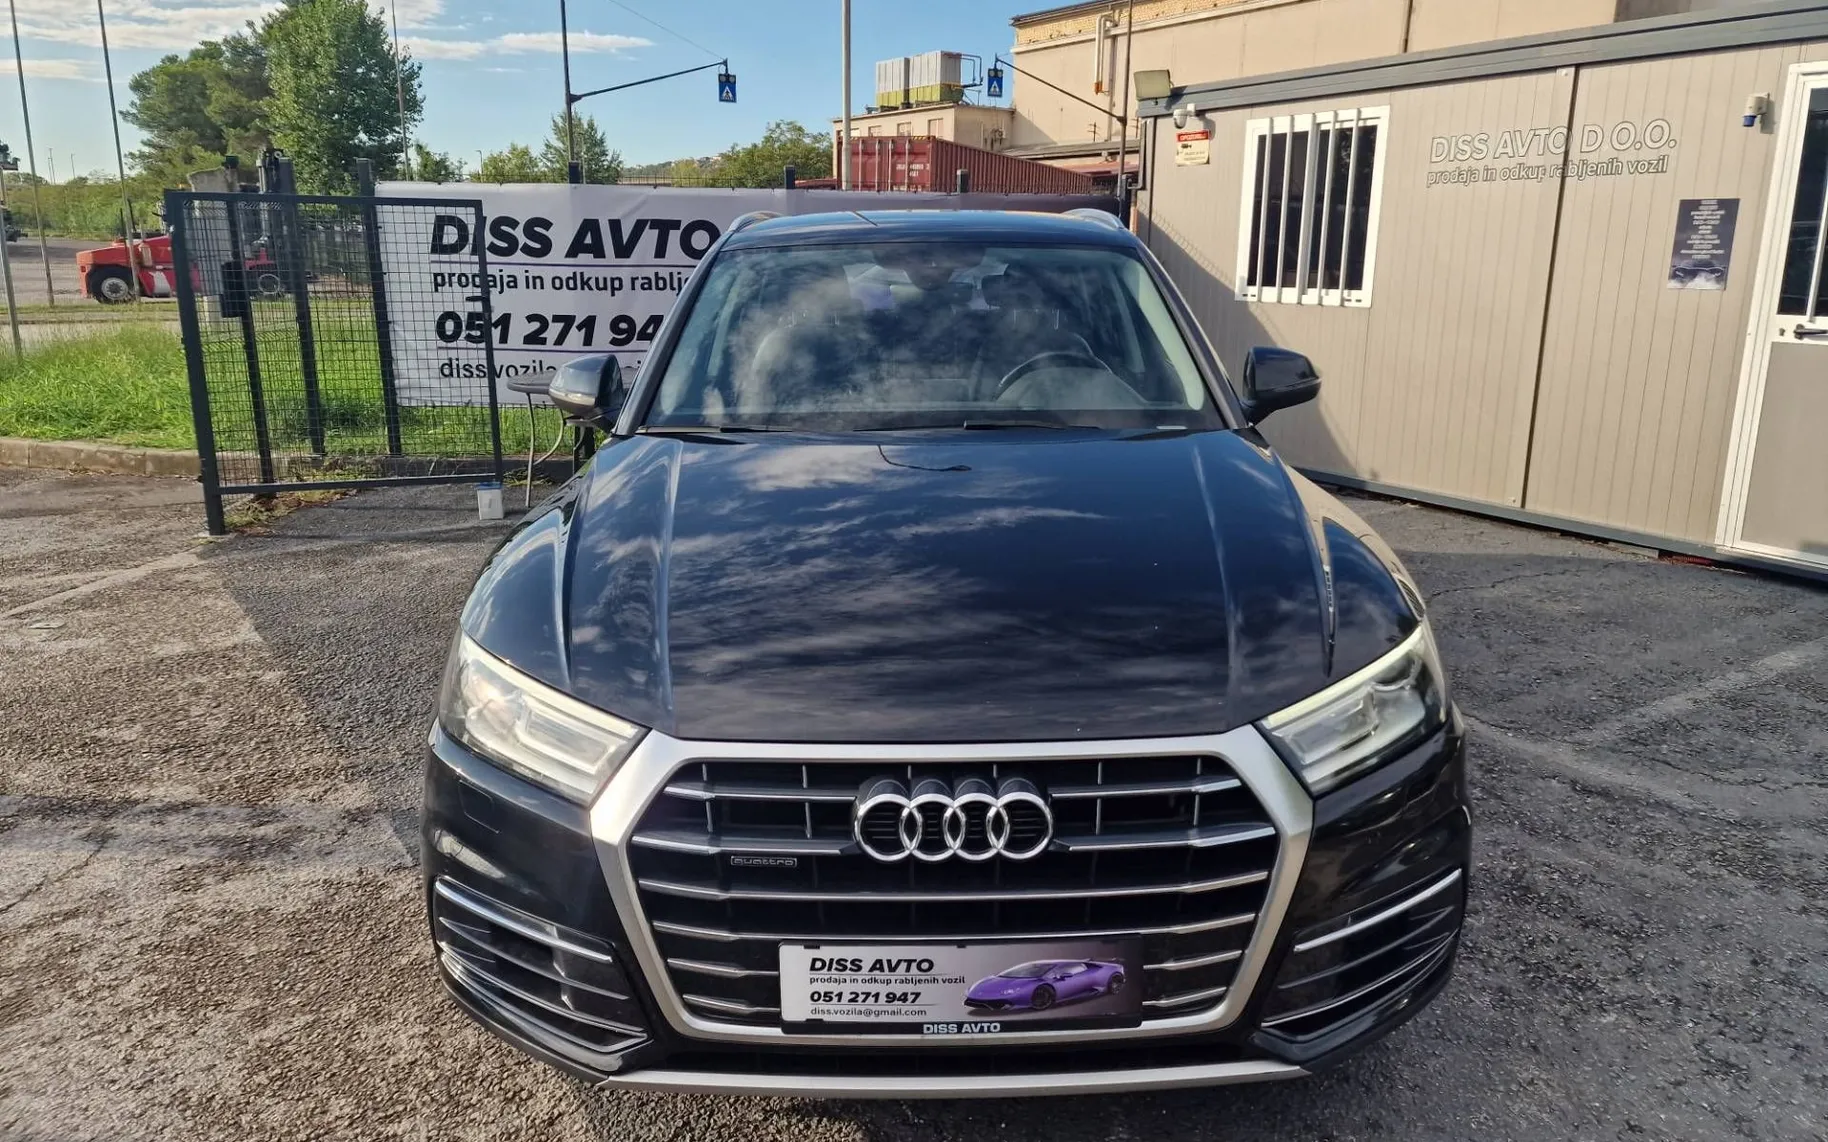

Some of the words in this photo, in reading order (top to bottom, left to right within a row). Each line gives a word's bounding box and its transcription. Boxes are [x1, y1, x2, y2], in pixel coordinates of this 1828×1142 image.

[1430, 132, 1490, 163] DISS
[1493, 125, 1573, 159] AVTO
[1580, 124, 1604, 153] D
[1427, 166, 1480, 188] prodaja
[1482, 165, 1497, 182] in
[1549, 157, 1623, 180] rabljenih
[1627, 154, 1669, 174] vozil
[564, 218, 721, 260] AVTO
[524, 269, 545, 290] in
[551, 271, 624, 297] odkup
[630, 271, 691, 296] rablj
[436, 311, 512, 344] 051
[522, 313, 597, 346] 271
[734, 857, 794, 866] quattro
[809, 957, 863, 972] DISS
[868, 958, 934, 973] AVTO
[809, 976, 847, 985] prodaja
[850, 976, 858, 984] in
[860, 976, 892, 986] odkup
[894, 976, 939, 986] rabljenih
[941, 976, 965, 984] vozil
[810, 991, 843, 1003] 051
[848, 991, 881, 1004] 271
[884, 991, 921, 1004] 947
[810, 1006, 927, 1017] diss.vozila@gmail.com
[923, 1024, 958, 1034] DISS
[961, 1023, 1001, 1034] AVTO
